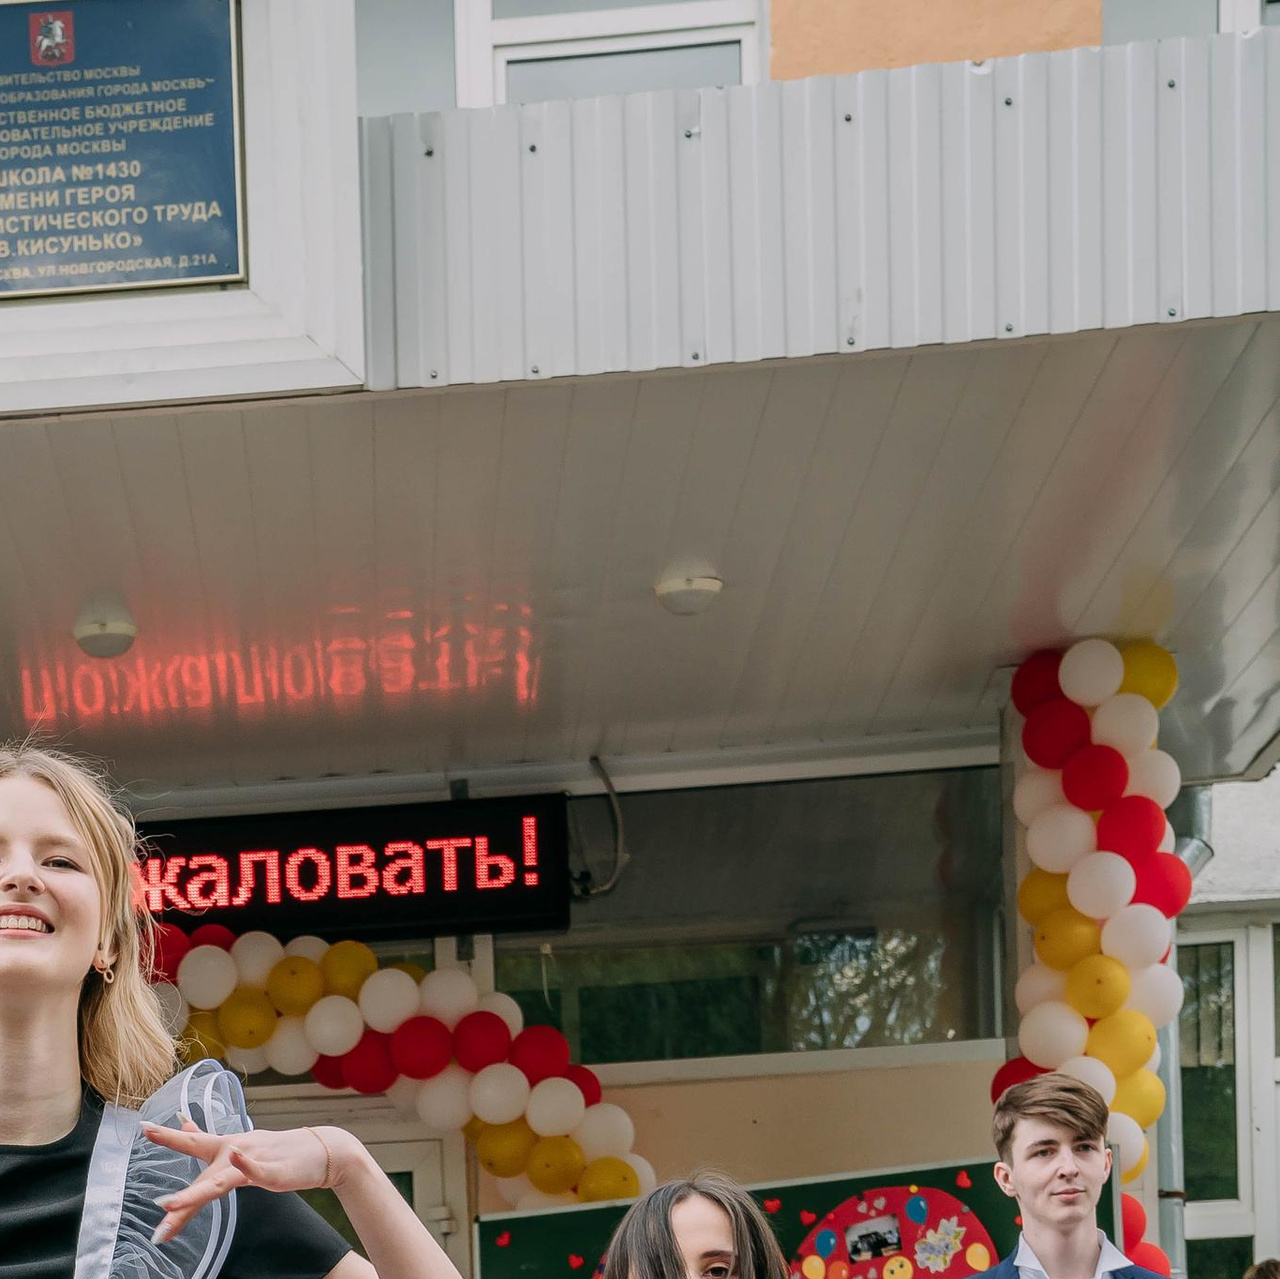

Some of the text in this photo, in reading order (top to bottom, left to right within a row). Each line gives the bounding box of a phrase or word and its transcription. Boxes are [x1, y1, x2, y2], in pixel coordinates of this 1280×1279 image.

[83, 65, 141, 80] МОСКВЫ
[97, 82, 148, 97] ГОРОДА
[85, 98, 187, 119] БЮДЖЕТНОЕ
[108, 113, 215, 135] УЧРЕЖДЕНИЕ
[56, 138, 126, 156] МОСКВЫ
[72, 160, 141, 181] №1430
[65, 184, 135, 206] ГЕРОЯ
[153, 200, 222, 224] ТРУДА
[132, 815, 539, 912] жаловать!
